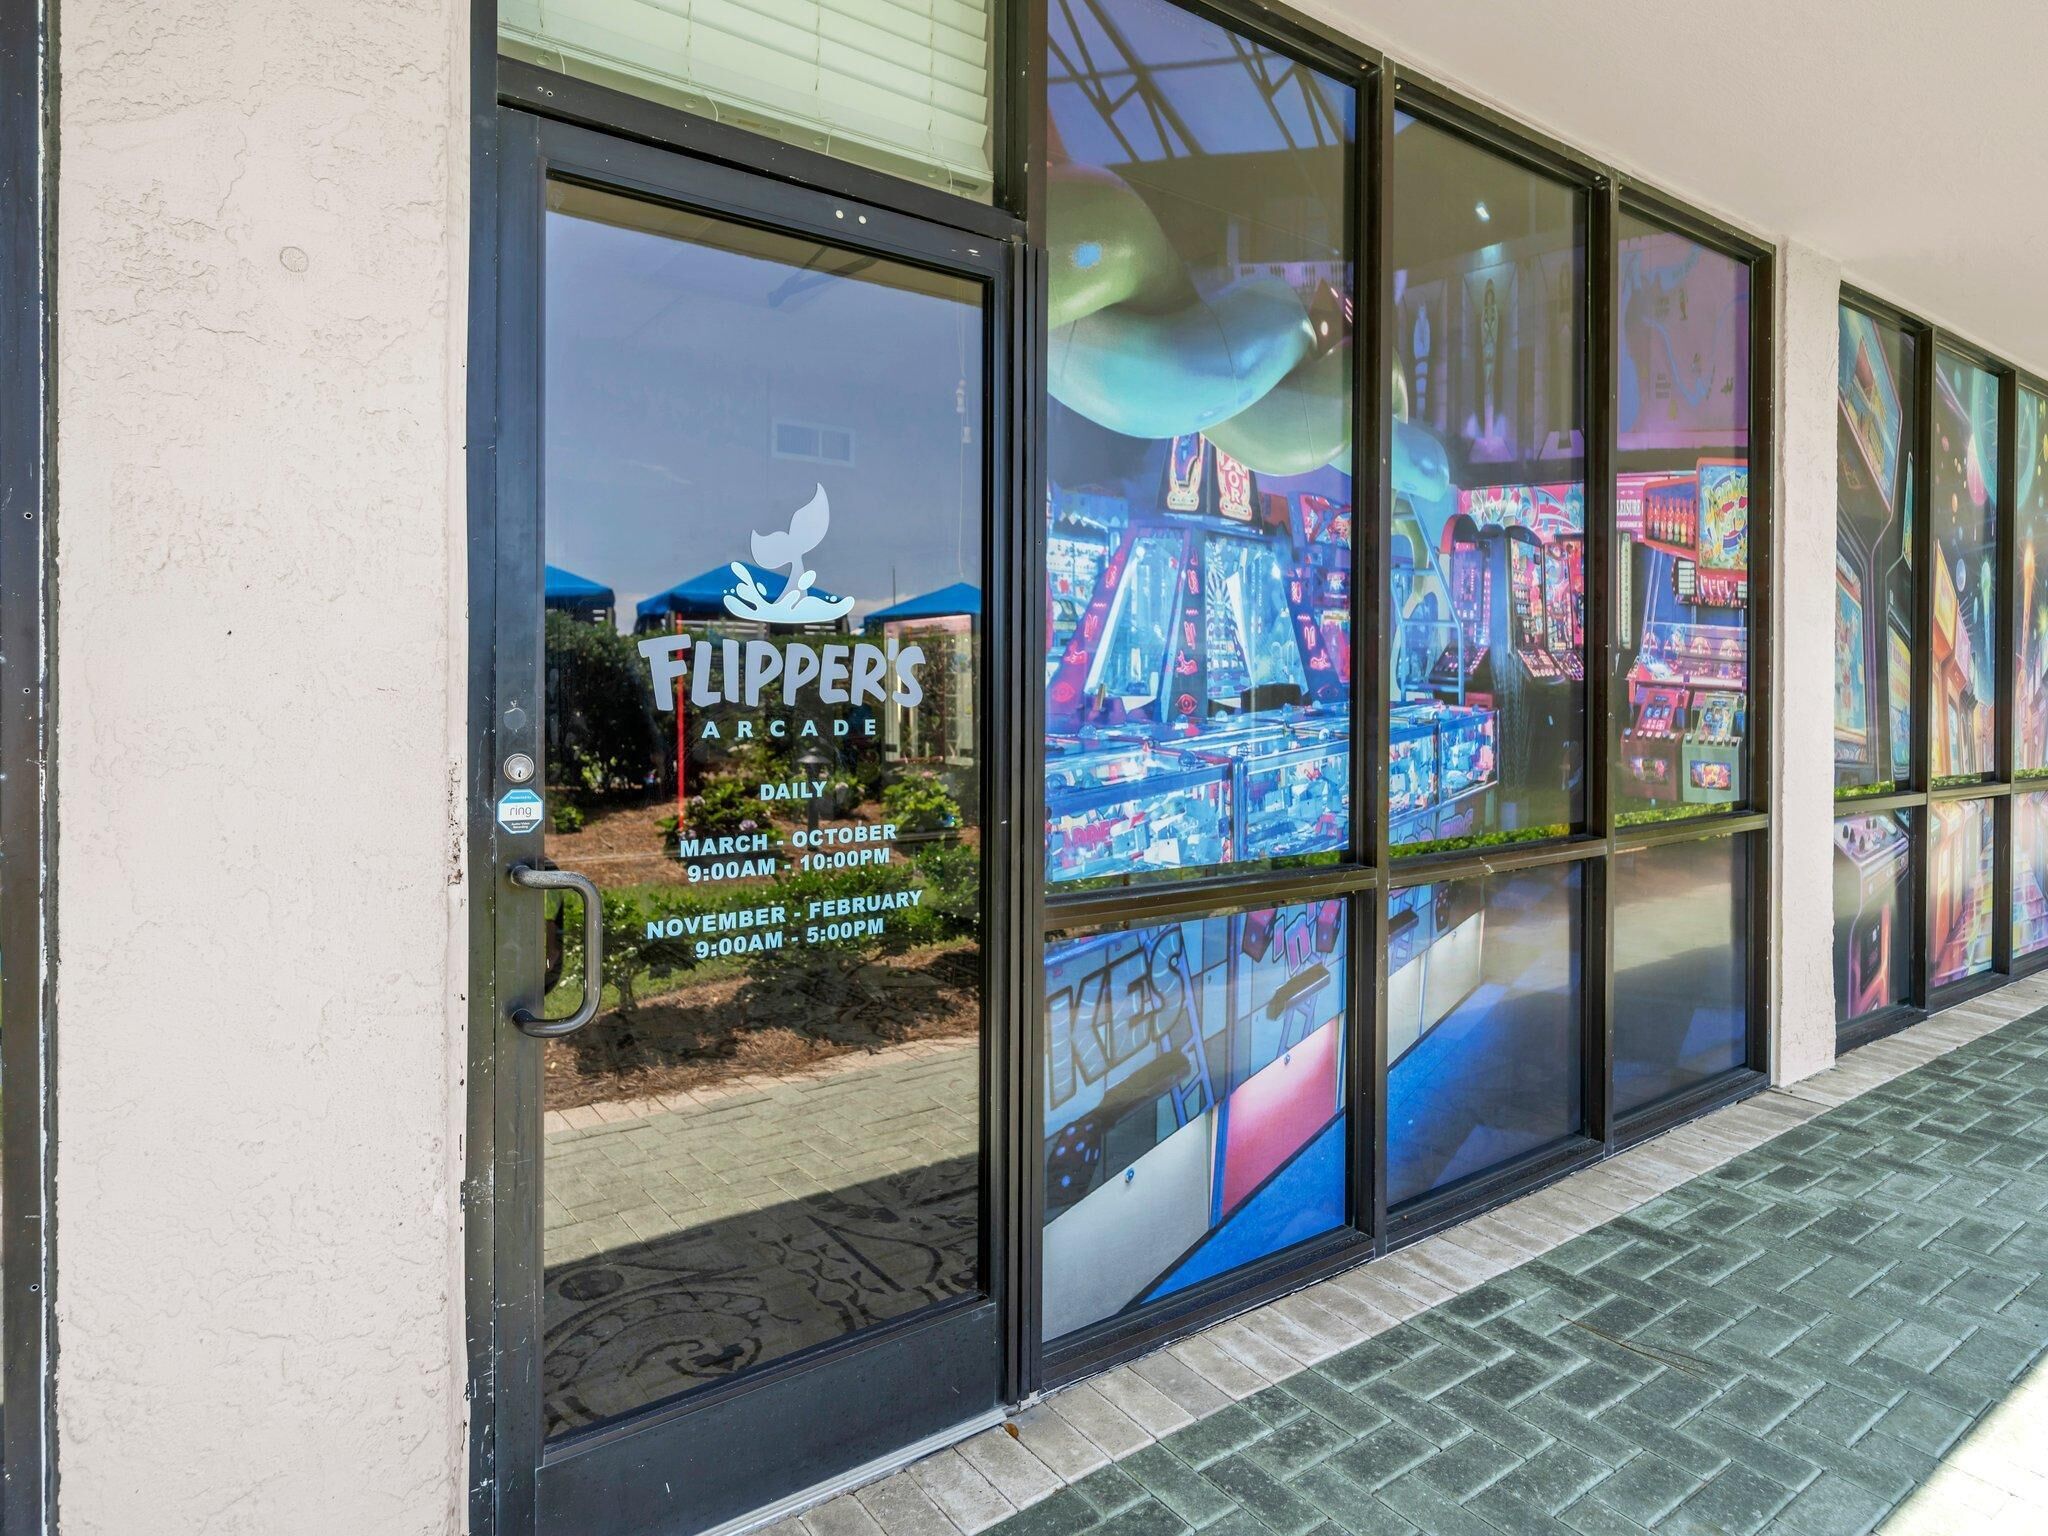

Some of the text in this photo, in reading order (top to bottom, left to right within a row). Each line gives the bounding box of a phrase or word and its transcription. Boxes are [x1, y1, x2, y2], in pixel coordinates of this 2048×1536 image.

[638, 633, 926, 711] FLIPPER'S
[701, 718, 876, 739] ARCADE
[760, 781, 827, 800] DAILY
[510, 805, 532, 818] ring
[680, 833, 768, 858] MARCH
[792, 824, 897, 848] OCTOBER
[687, 858, 776, 883] 9:00AM
[800, 847, 890, 872] 10:00PM
[647, 906, 786, 940] NOVEMBER
[809, 890, 923, 919] FEBRUARY
[695, 931, 783, 959] 9:00AM
[807, 918, 884, 944] 5:00PM
